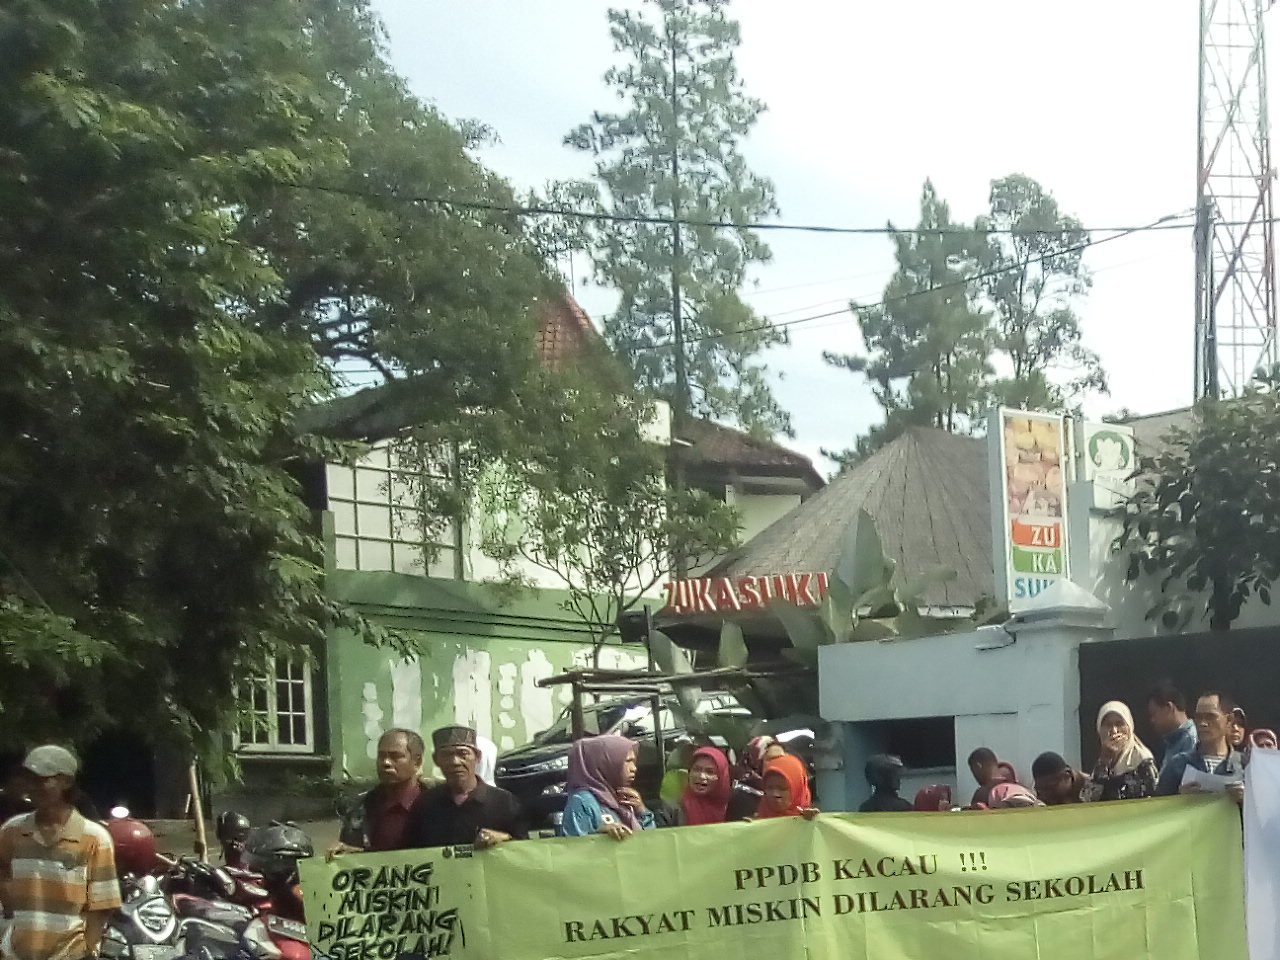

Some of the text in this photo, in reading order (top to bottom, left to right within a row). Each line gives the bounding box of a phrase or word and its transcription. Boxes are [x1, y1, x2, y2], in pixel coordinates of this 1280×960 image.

[1031, 526, 1056, 546] ZU
[1032, 552, 1058, 573] KA
[332, 862, 434, 892] ORANG
[734, 852, 988, 891] PPDB KACAU !!!
[564, 869, 1146, 943] RAKYAT MISKIN DILARANG SEKOLAH
[317, 907, 460, 943] DILARANG
